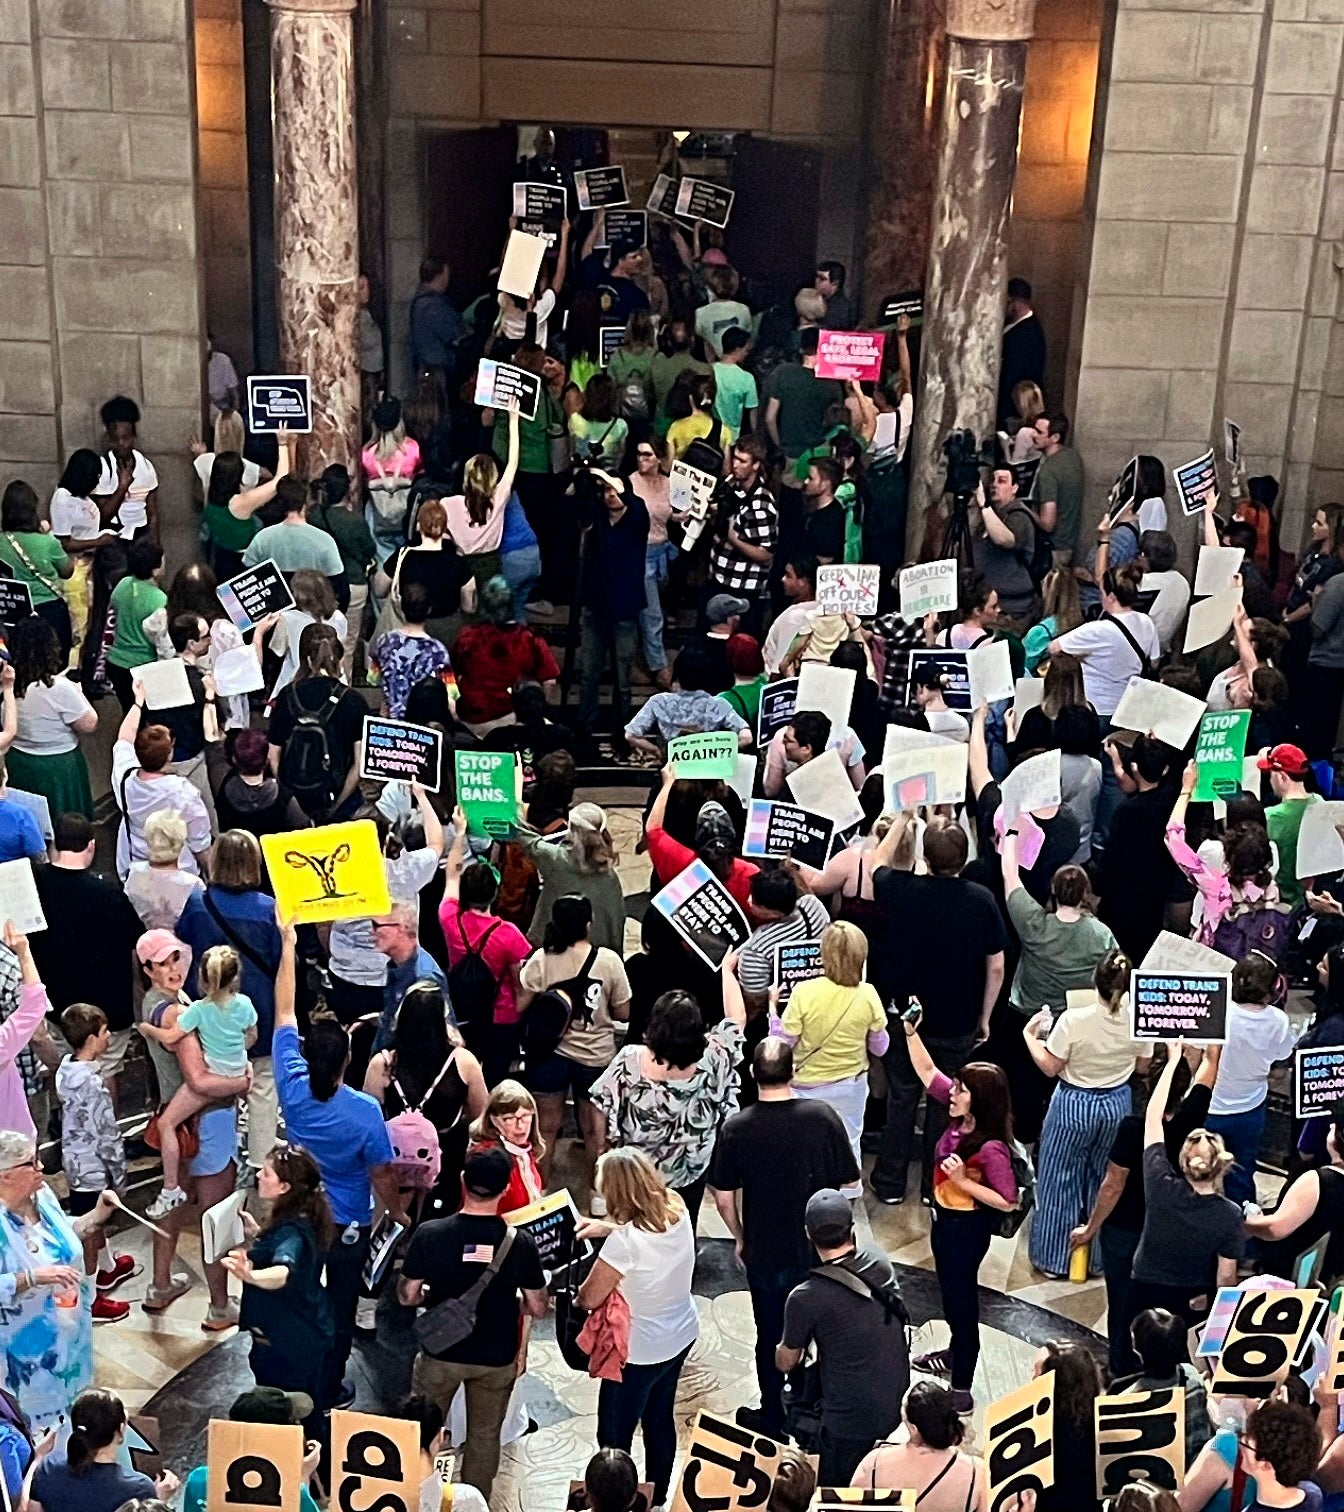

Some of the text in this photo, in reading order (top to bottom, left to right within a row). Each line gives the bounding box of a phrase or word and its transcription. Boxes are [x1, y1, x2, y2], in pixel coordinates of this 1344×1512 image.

[1203, 716, 1240, 730] STOP
[1201, 732, 1228, 746] THE
[672, 748, 732, 762] AGAIN??
[1196, 748, 1236, 763] BANS.
[459, 756, 502, 770] STOP
[461, 772, 492, 785] THE
[461, 787, 510, 802] BANS.
[775, 808, 806, 821] TRANS
[771, 829, 810, 843] HERE TO
[772, 818, 826, 840] PEOPLE ARE
[706, 883, 732, 913] TRANS
[688, 898, 722, 935] HERE TO
[697, 892, 740, 942] PEOPLE ARE
[1138, 979, 1218, 991] DEFEND TRANS
[1138, 992, 1211, 1006] KIDS: TODAY,
[1138, 1004, 1211, 1018] TOMORROW,
[1138, 1018, 1198, 1029] & FOREVER.
[1304, 1054, 1344, 1067] DEFEND
[1304, 1070, 1330, 1078] KIDS:
[1304, 1096, 1310, 1104] &
